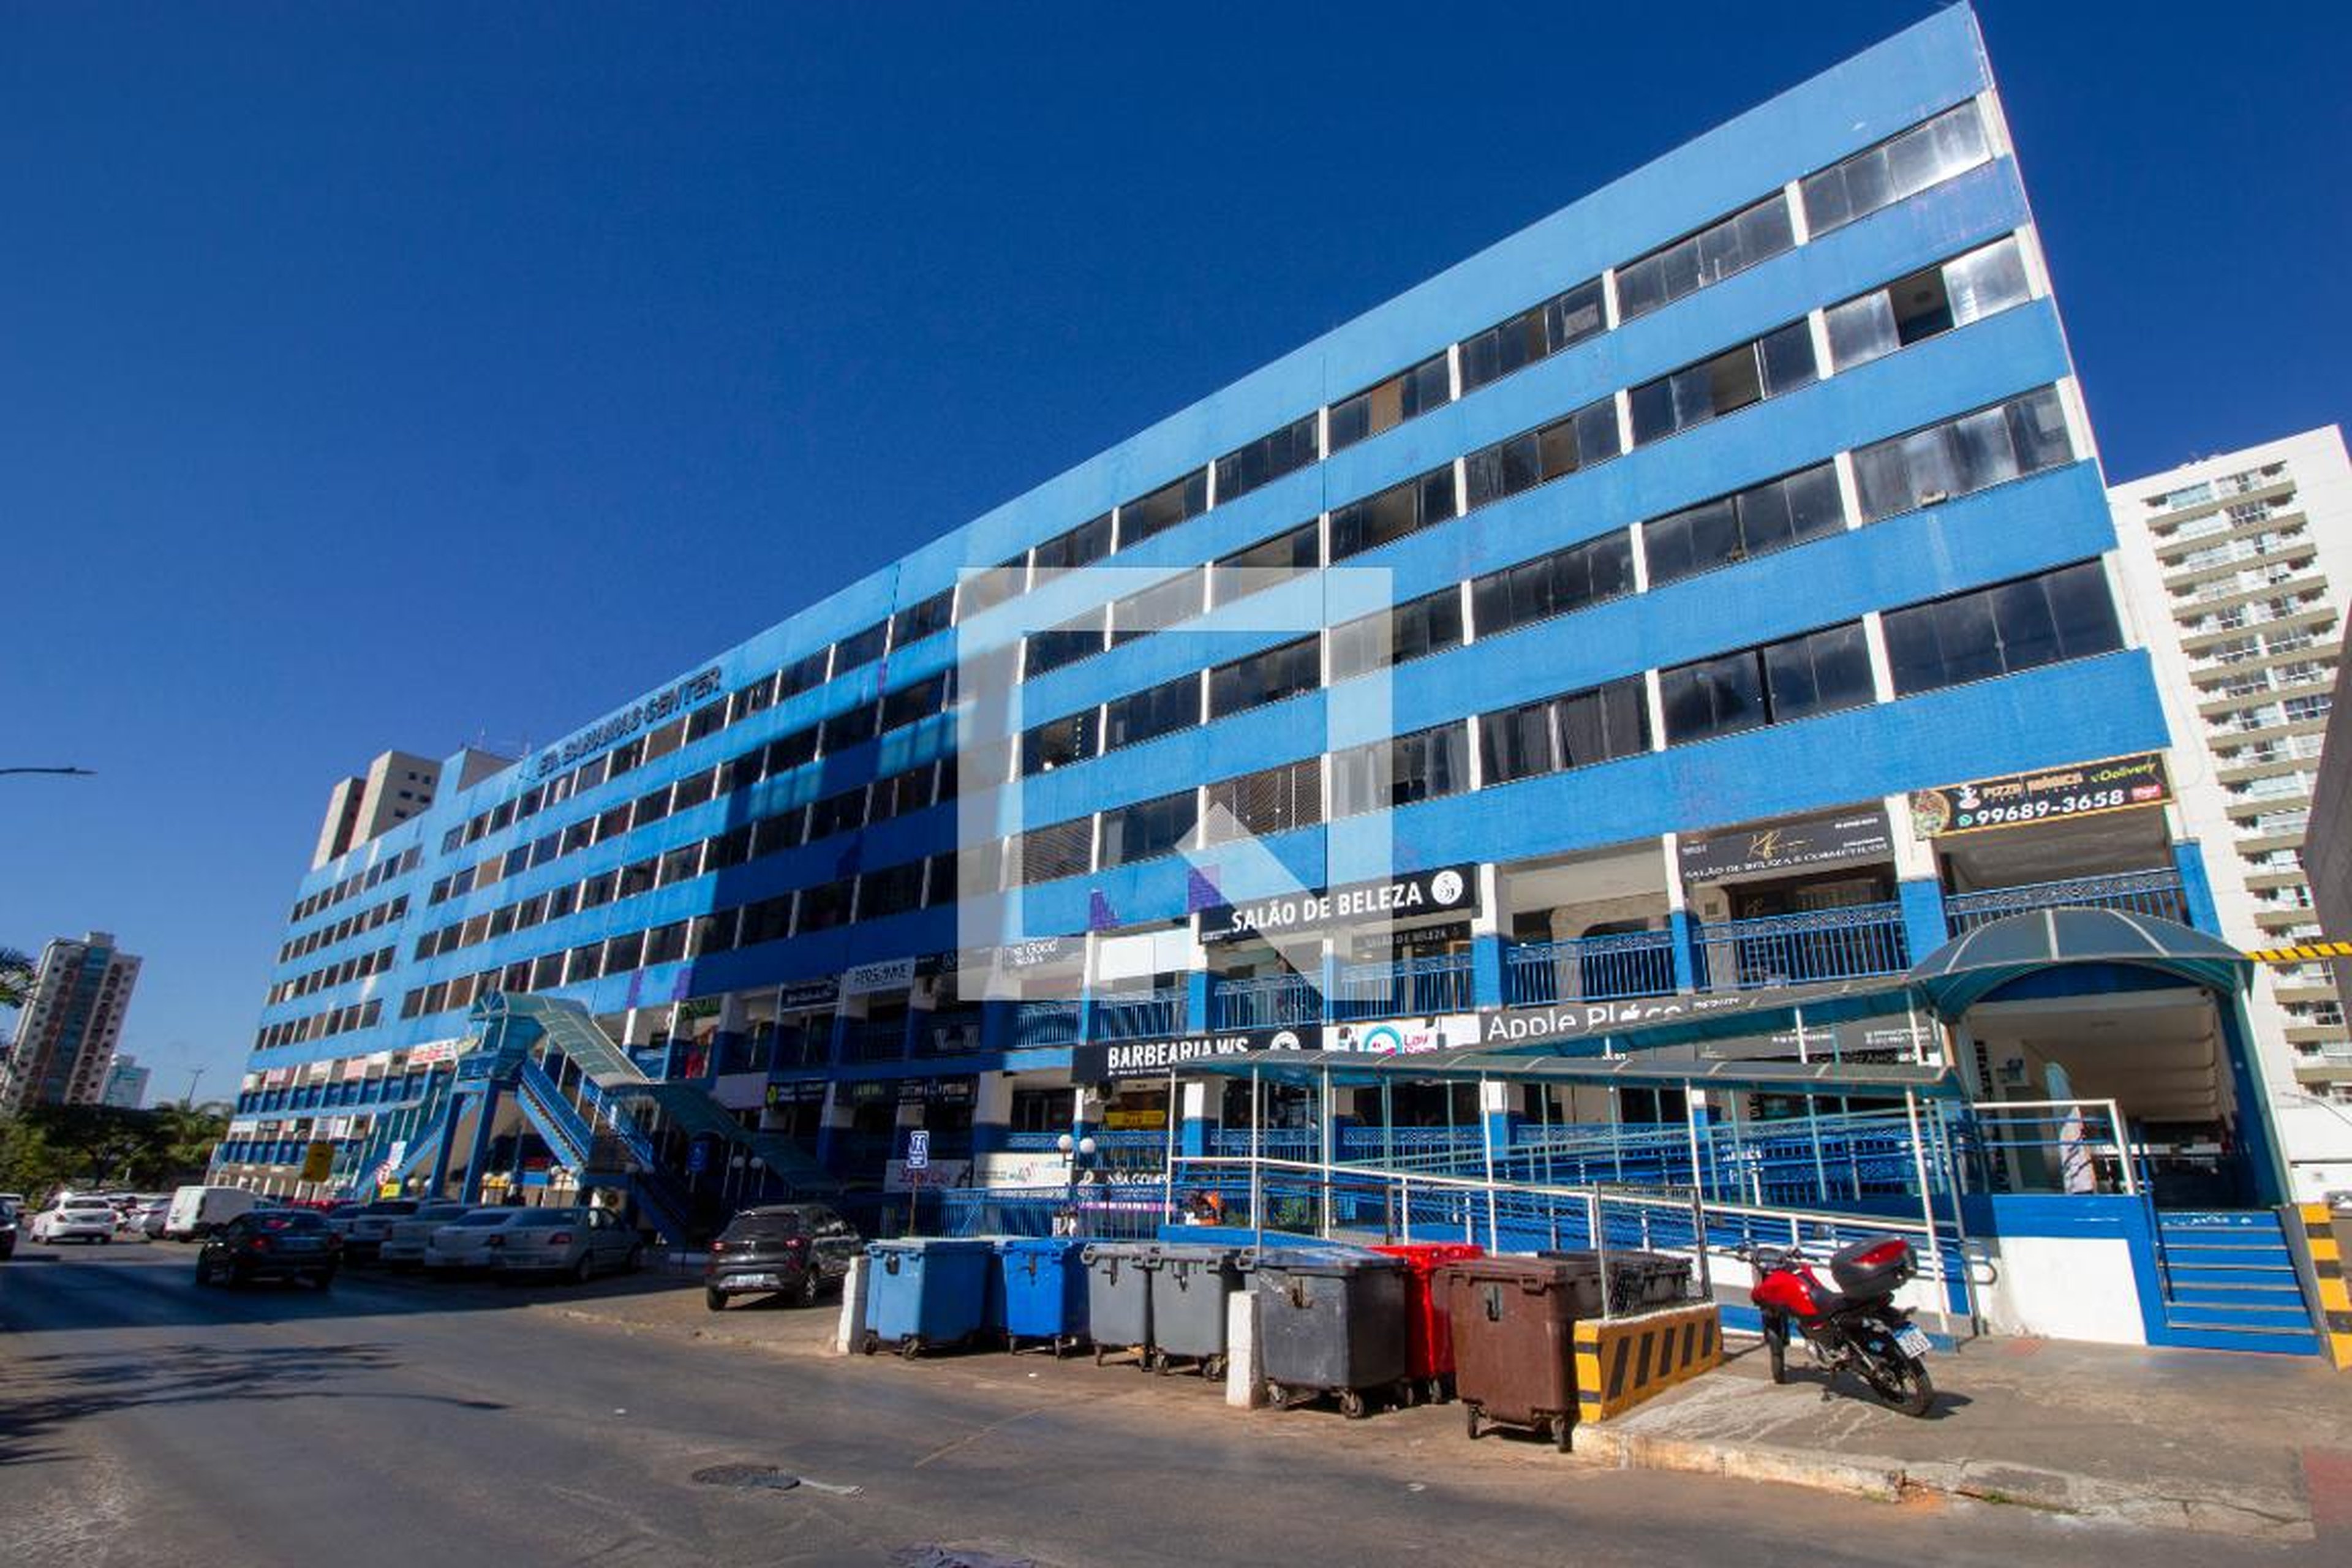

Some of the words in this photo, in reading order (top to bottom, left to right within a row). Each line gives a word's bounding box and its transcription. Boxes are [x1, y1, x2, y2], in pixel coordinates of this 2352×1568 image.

[1975, 789, 2125, 825] 99689-3658
[1231, 898, 1296, 933] SALÃO
[1303, 896, 1332, 922] DE
[1337, 881, 1423, 916] BELEZA
[1107, 1039, 1213, 1069] BARBEARIA
[1216, 1037, 1249, 1054] WS
